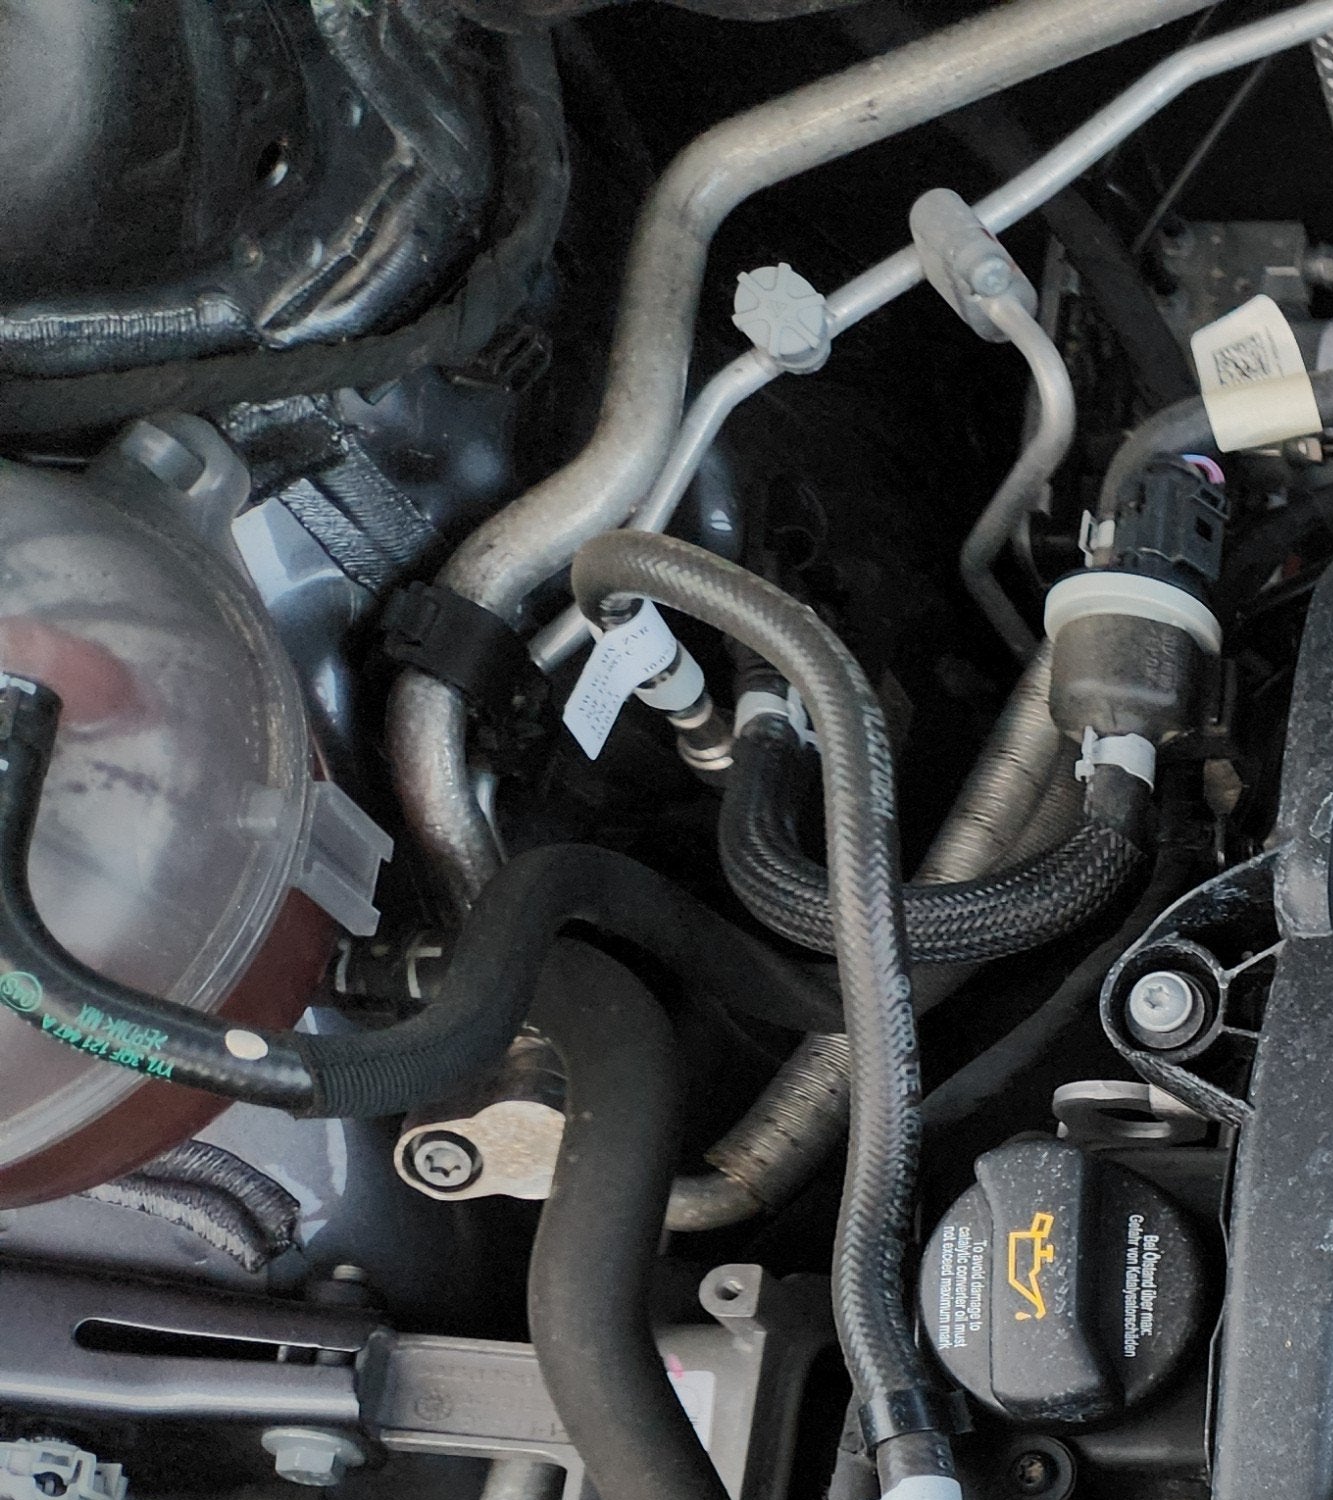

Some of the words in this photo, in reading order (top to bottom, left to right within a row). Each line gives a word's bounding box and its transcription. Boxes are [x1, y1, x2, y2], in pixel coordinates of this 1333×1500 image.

[41, 1013, 56, 1029] A
[80, 1035, 109, 1054] 121
[944, 1226, 955, 1241] not
[1128, 1215, 1144, 1246] Gefahr
[955, 1227, 972, 1263] catalytic
[973, 1240, 987, 1252] To
[1144, 1235, 1159, 1250] Bei
[941, 1243, 954, 1275] exceed
[971, 1255, 985, 1279] avoid
[1127, 1248, 1138, 1264] von
[1142, 1252, 1161, 1287] Ölstand
[955, 1266, 968, 1308] converter
[939, 1278, 953, 1323] maximum
[967, 1281, 985, 1319] damage
[1123, 1266, 1140, 1357] Katalysatorschäden
[1141, 1290, 1157, 1311] über
[955, 1311, 968, 1321] oil
[970, 1322, 982, 1331] to
[939, 1325, 952, 1349] mark
[954, 1324, 967, 1347] must
